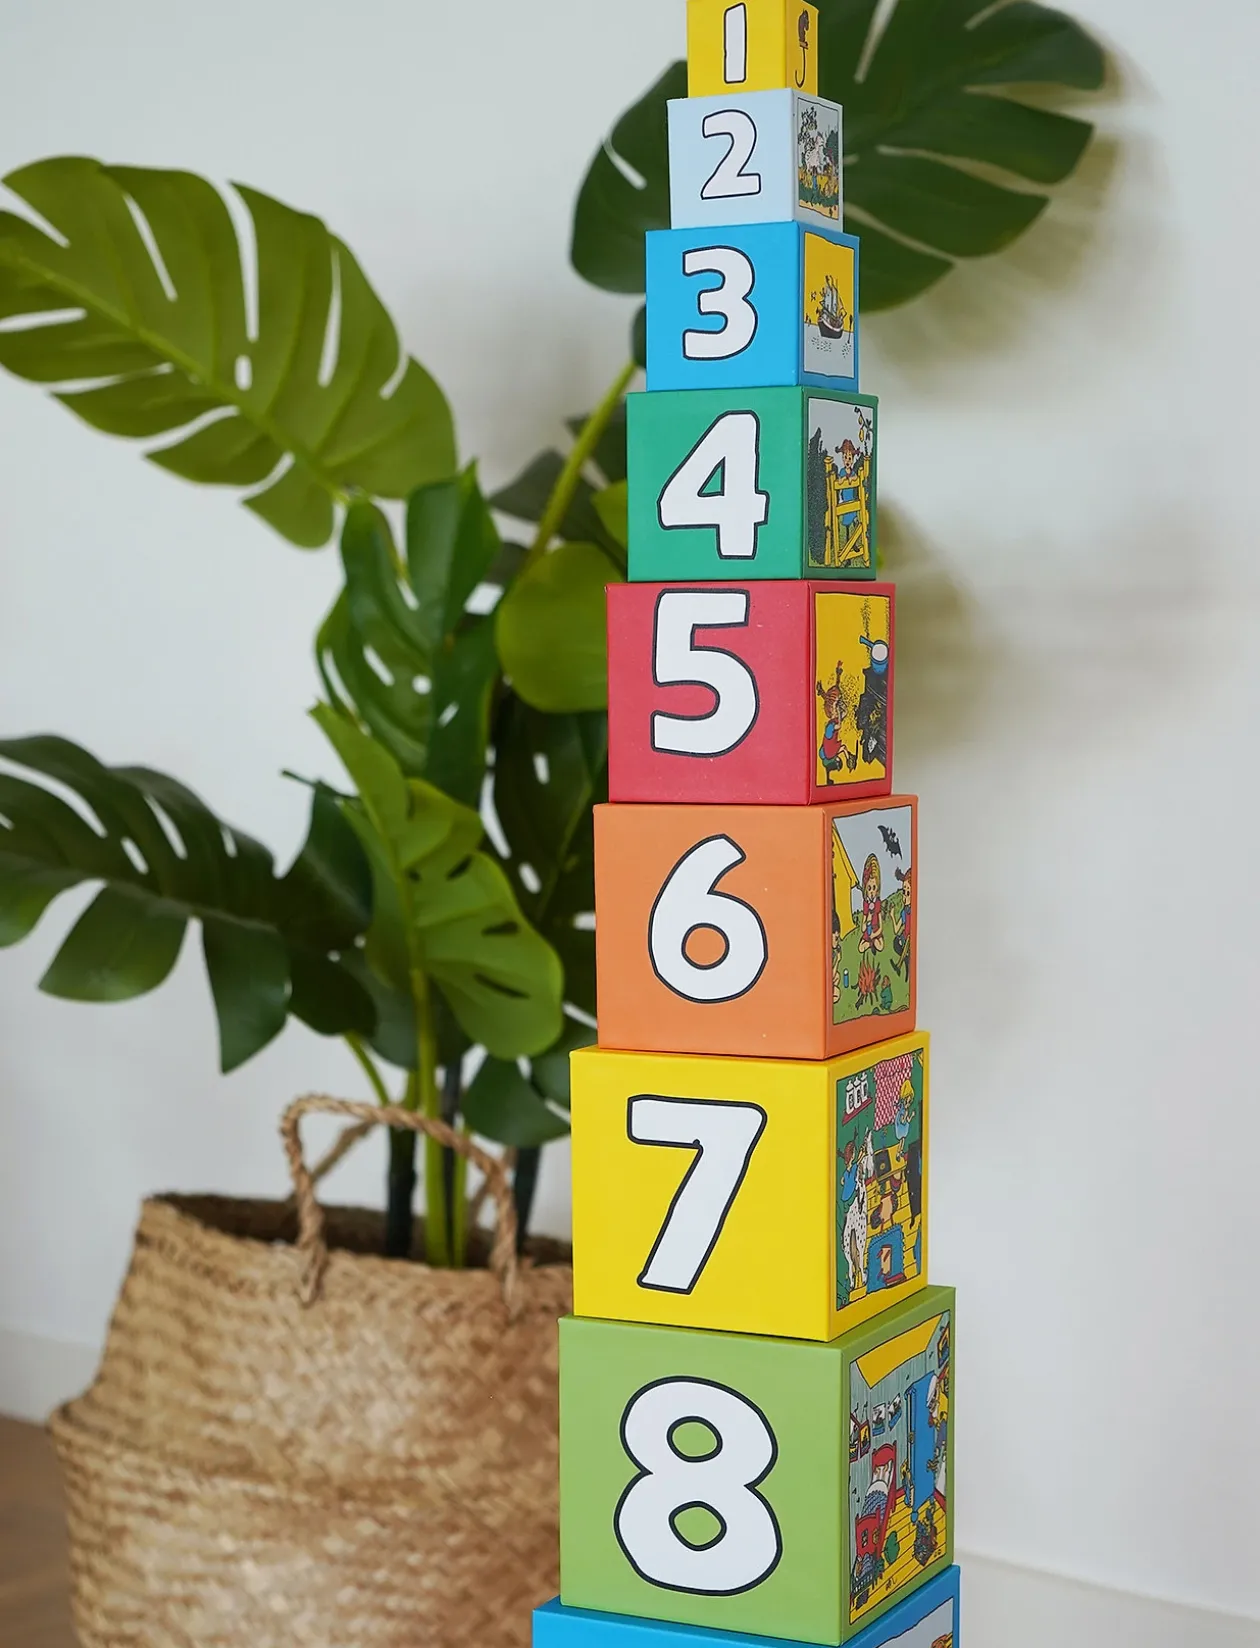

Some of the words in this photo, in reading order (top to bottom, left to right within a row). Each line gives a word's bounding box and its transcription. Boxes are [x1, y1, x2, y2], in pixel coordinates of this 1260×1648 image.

[724, 3, 747, 84] 1
[701, 110, 761, 200] 2
[683, 246, 758, 360] 3
[658, 411, 769, 559] 4
[651, 589, 759, 757] 5
[648, 834, 768, 1003] 6
[628, 1095, 766, 1294] 7
[614, 1377, 782, 1595] 8
